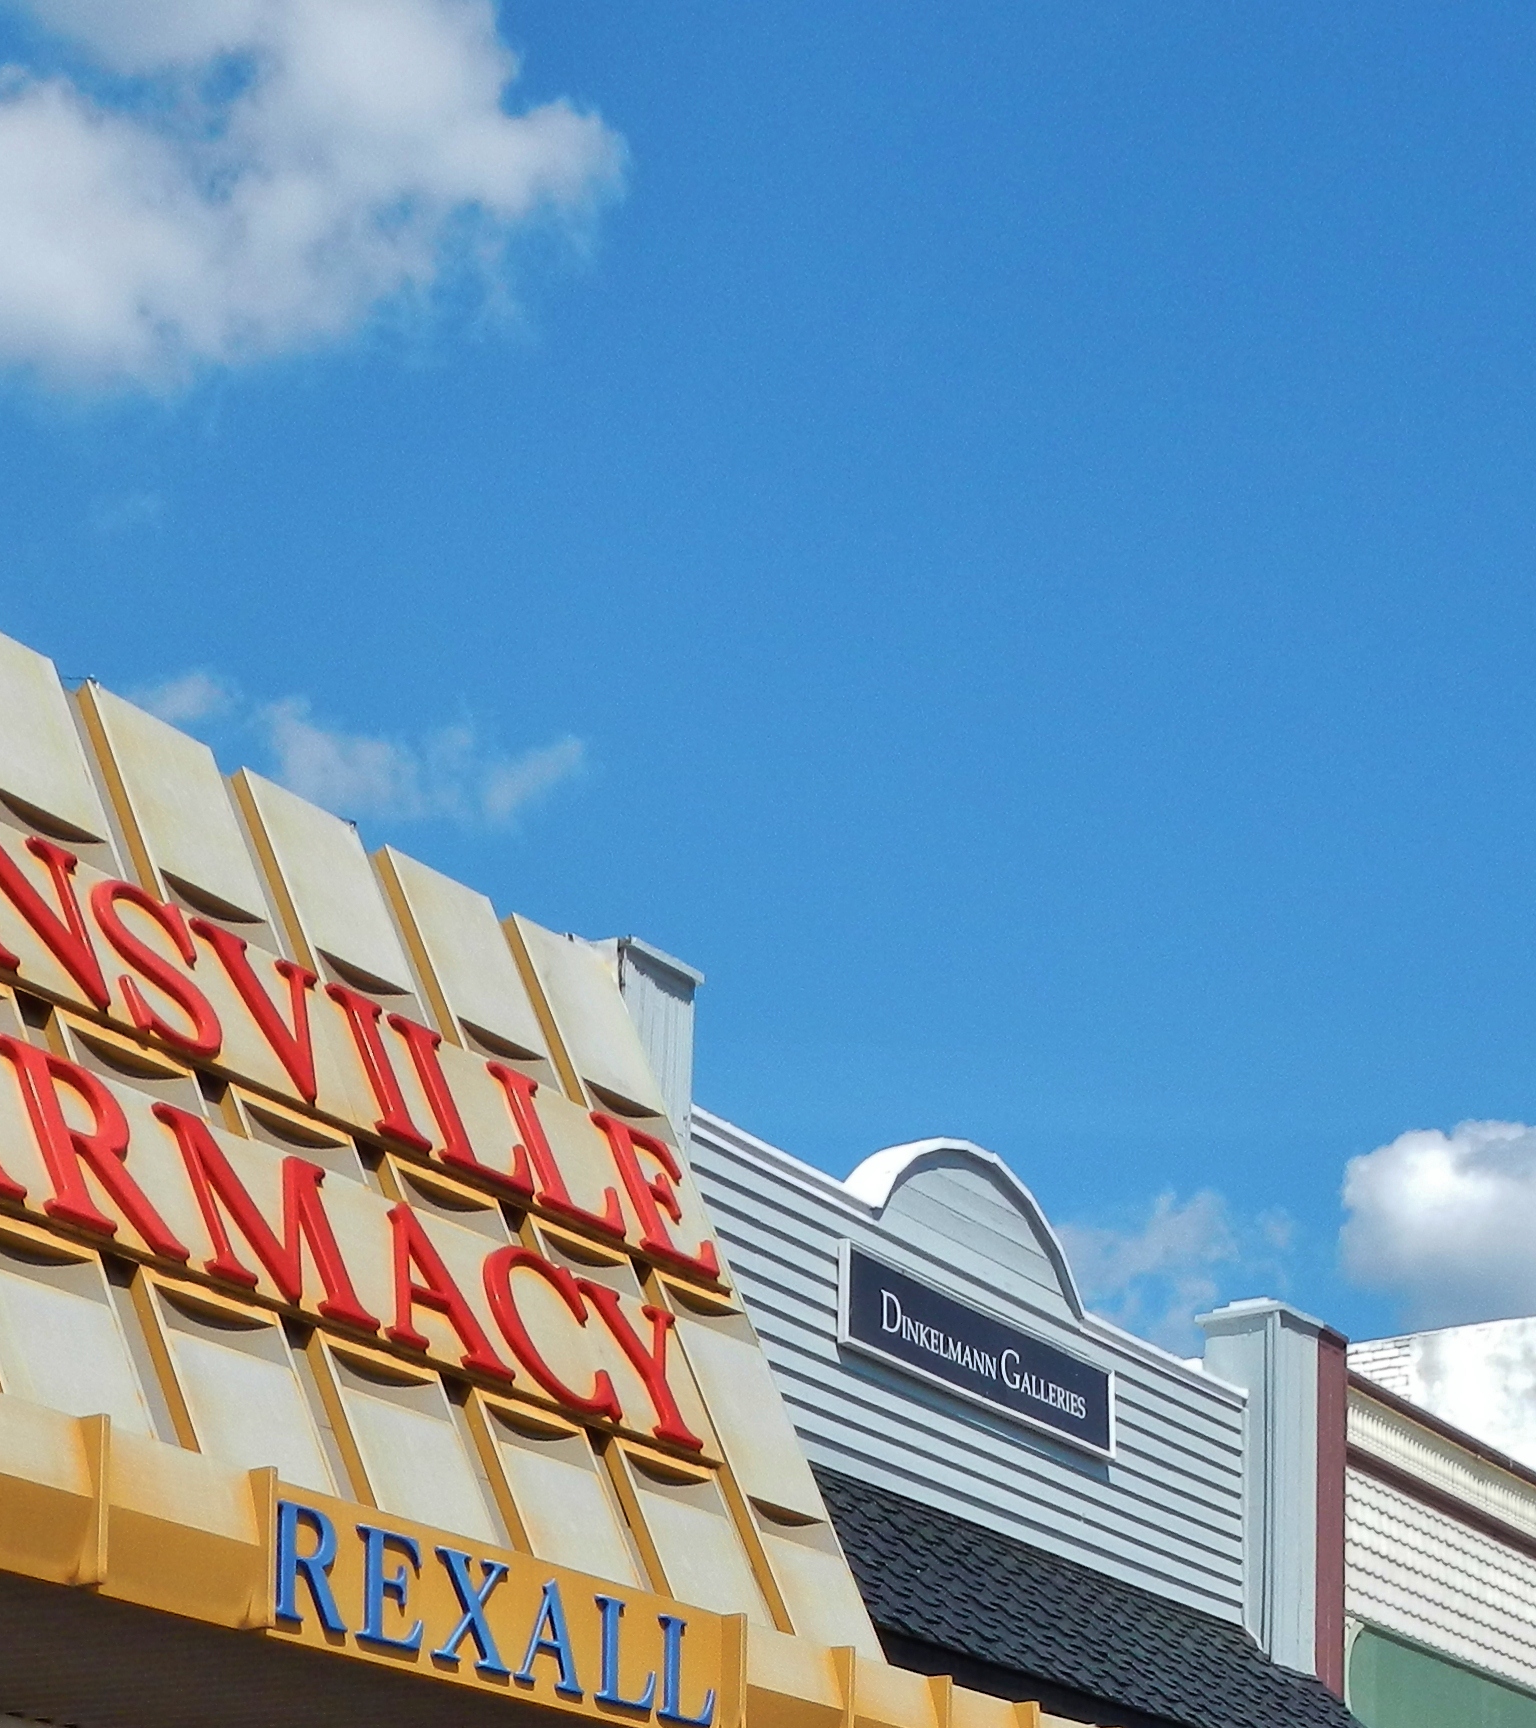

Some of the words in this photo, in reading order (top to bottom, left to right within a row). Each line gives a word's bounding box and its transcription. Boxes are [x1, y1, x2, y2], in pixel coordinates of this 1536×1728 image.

[880, 1288, 997, 1381] DINKELMANN
[1000, 1348, 1087, 1420] GALLERIES
[275, 1499, 715, 1728] REXALL
